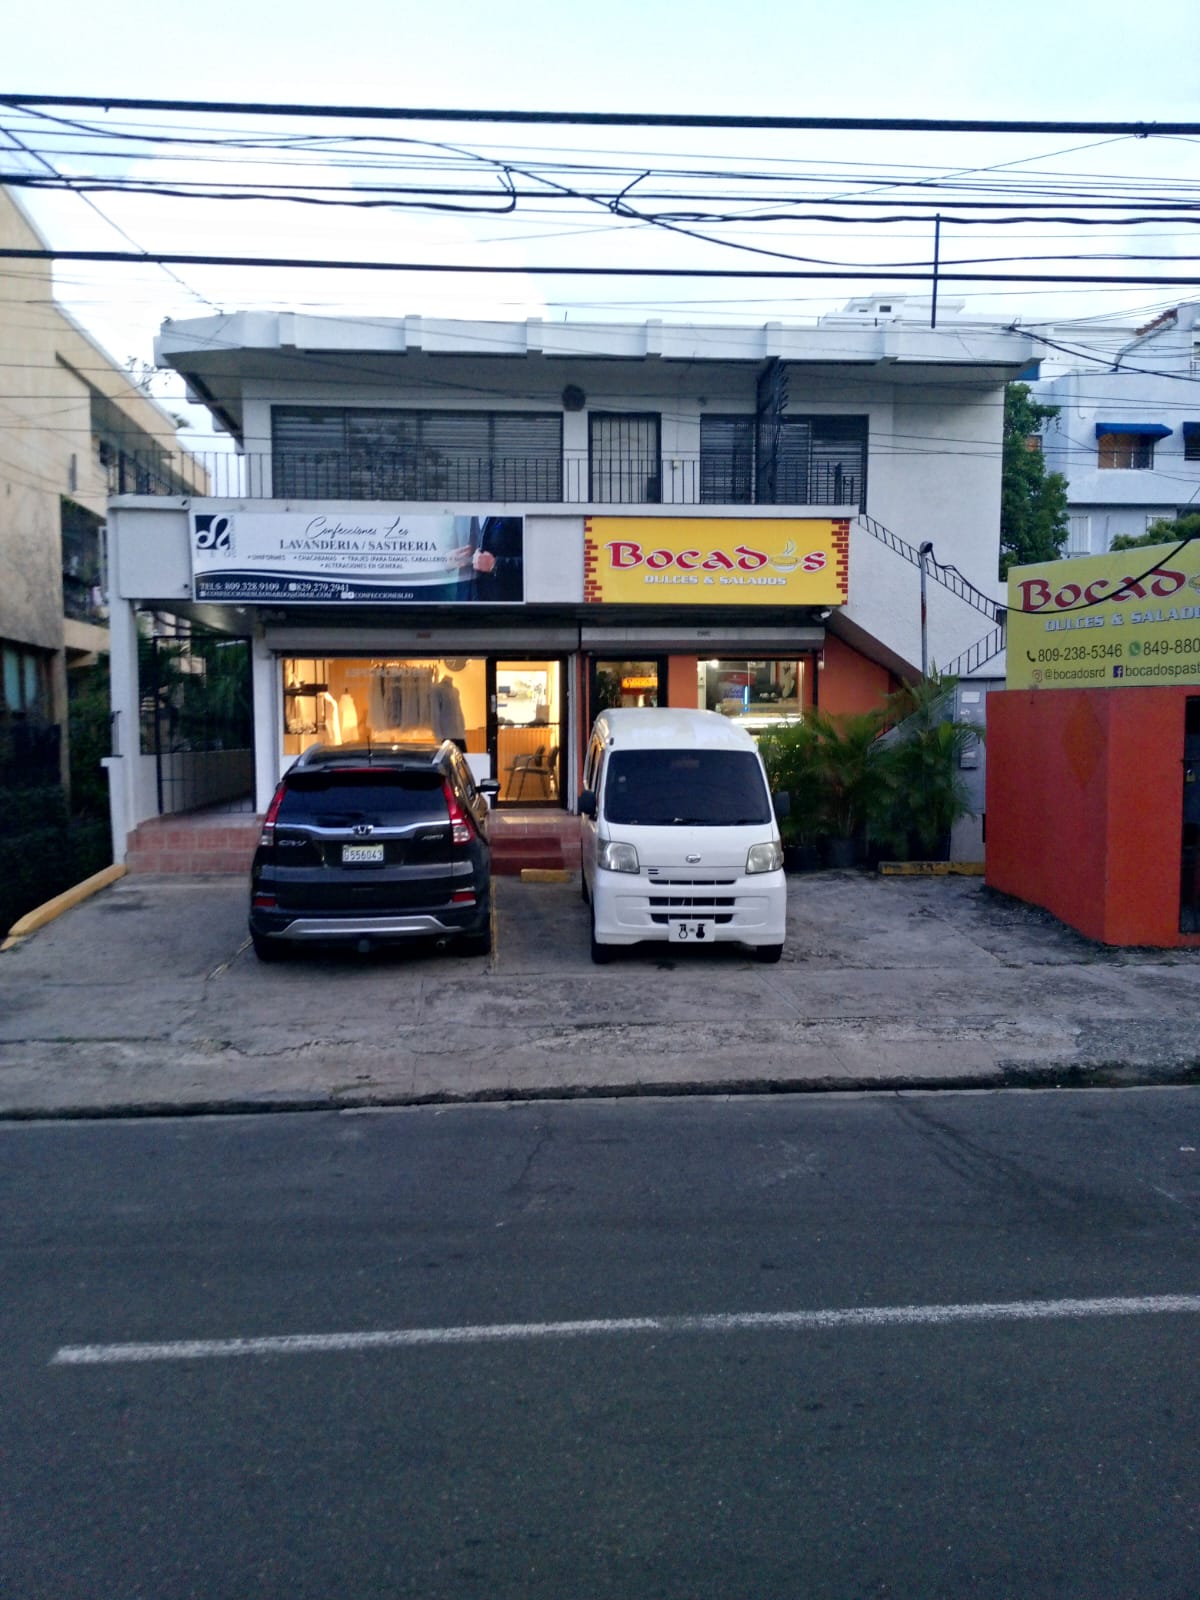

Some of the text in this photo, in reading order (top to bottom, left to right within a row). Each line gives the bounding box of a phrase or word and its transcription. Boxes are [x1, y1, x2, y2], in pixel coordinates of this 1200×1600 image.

[305, 516, 377, 540] Confecciones
[280, 539, 359, 550] LAVANDERIA
[368, 541, 437, 551] SASTRERIA
[644, 575, 786, 586] DULCES & SALADOS
[1045, 615, 1105, 632] DULCES
[1111, 613, 1124, 626] &
[1038, 643, 1123, 663] 809-238-5346
[1045, 667, 1106, 680] @bocadosrd
